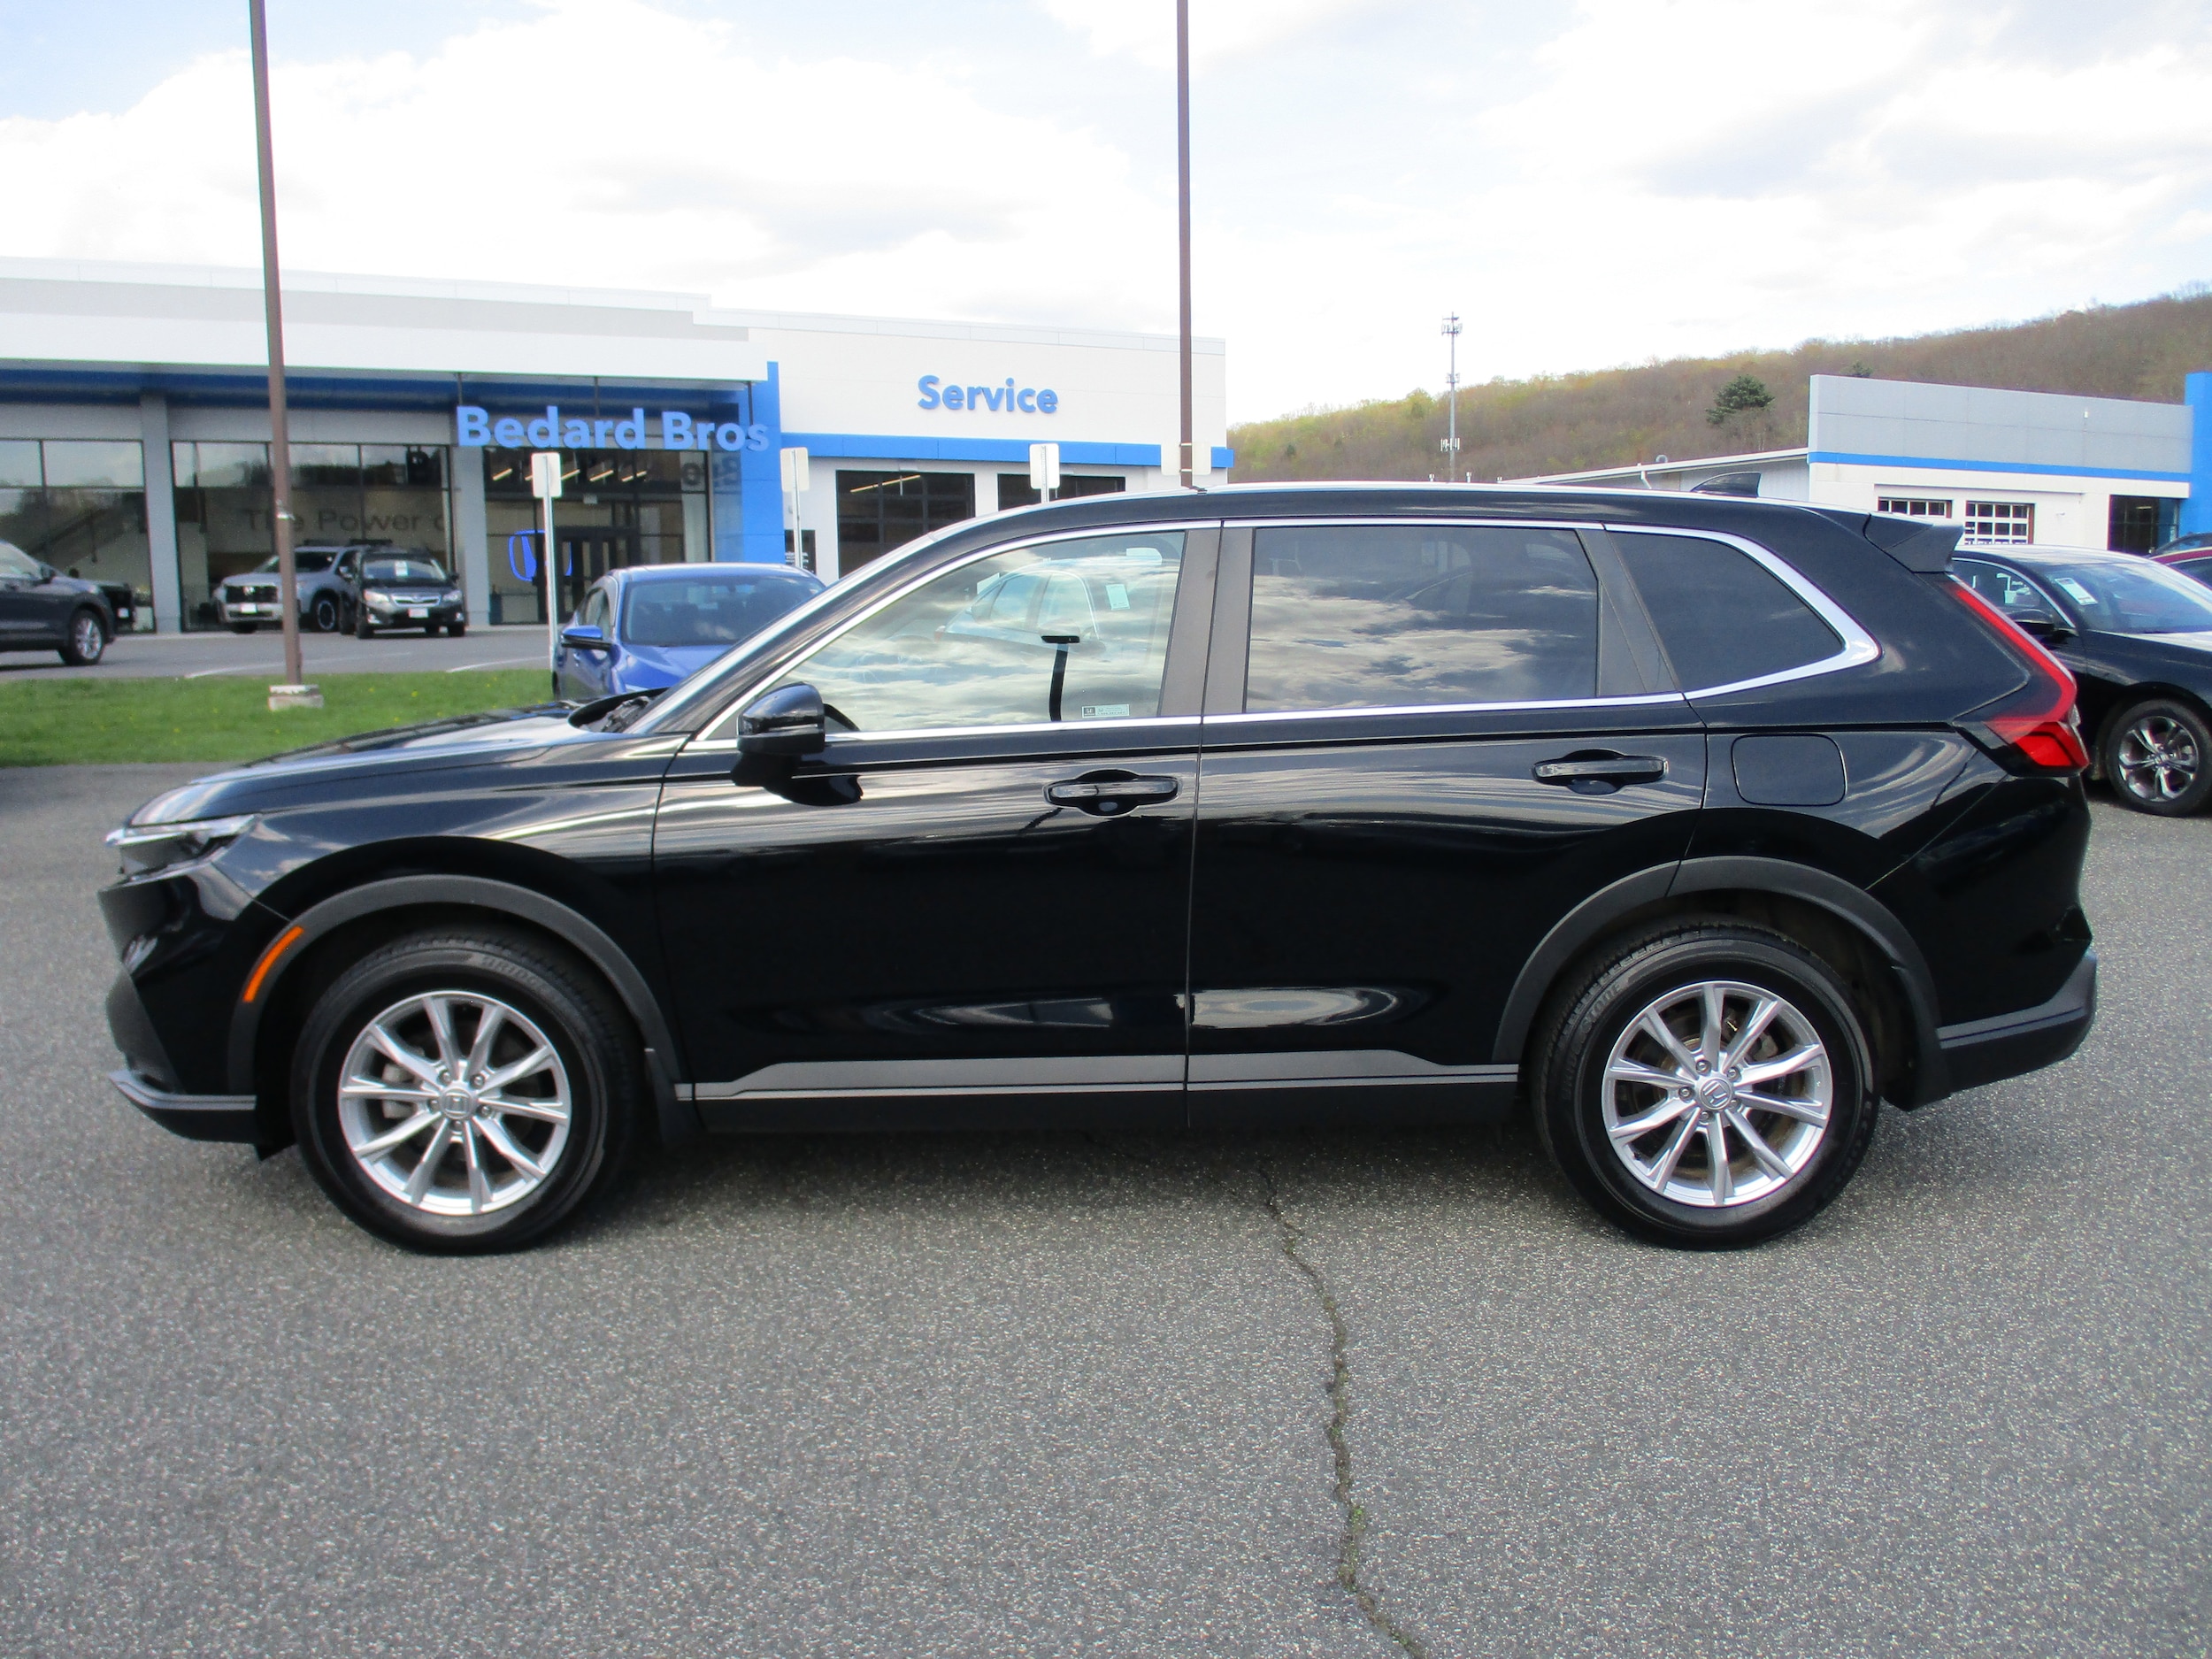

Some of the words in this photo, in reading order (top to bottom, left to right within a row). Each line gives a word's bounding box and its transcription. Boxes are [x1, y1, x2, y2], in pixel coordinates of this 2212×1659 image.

[918, 374, 1058, 414] Service
[456, 405, 648, 449] Bedard
[661, 411, 770, 451] Bros
[244, 508, 305, 532] Te
